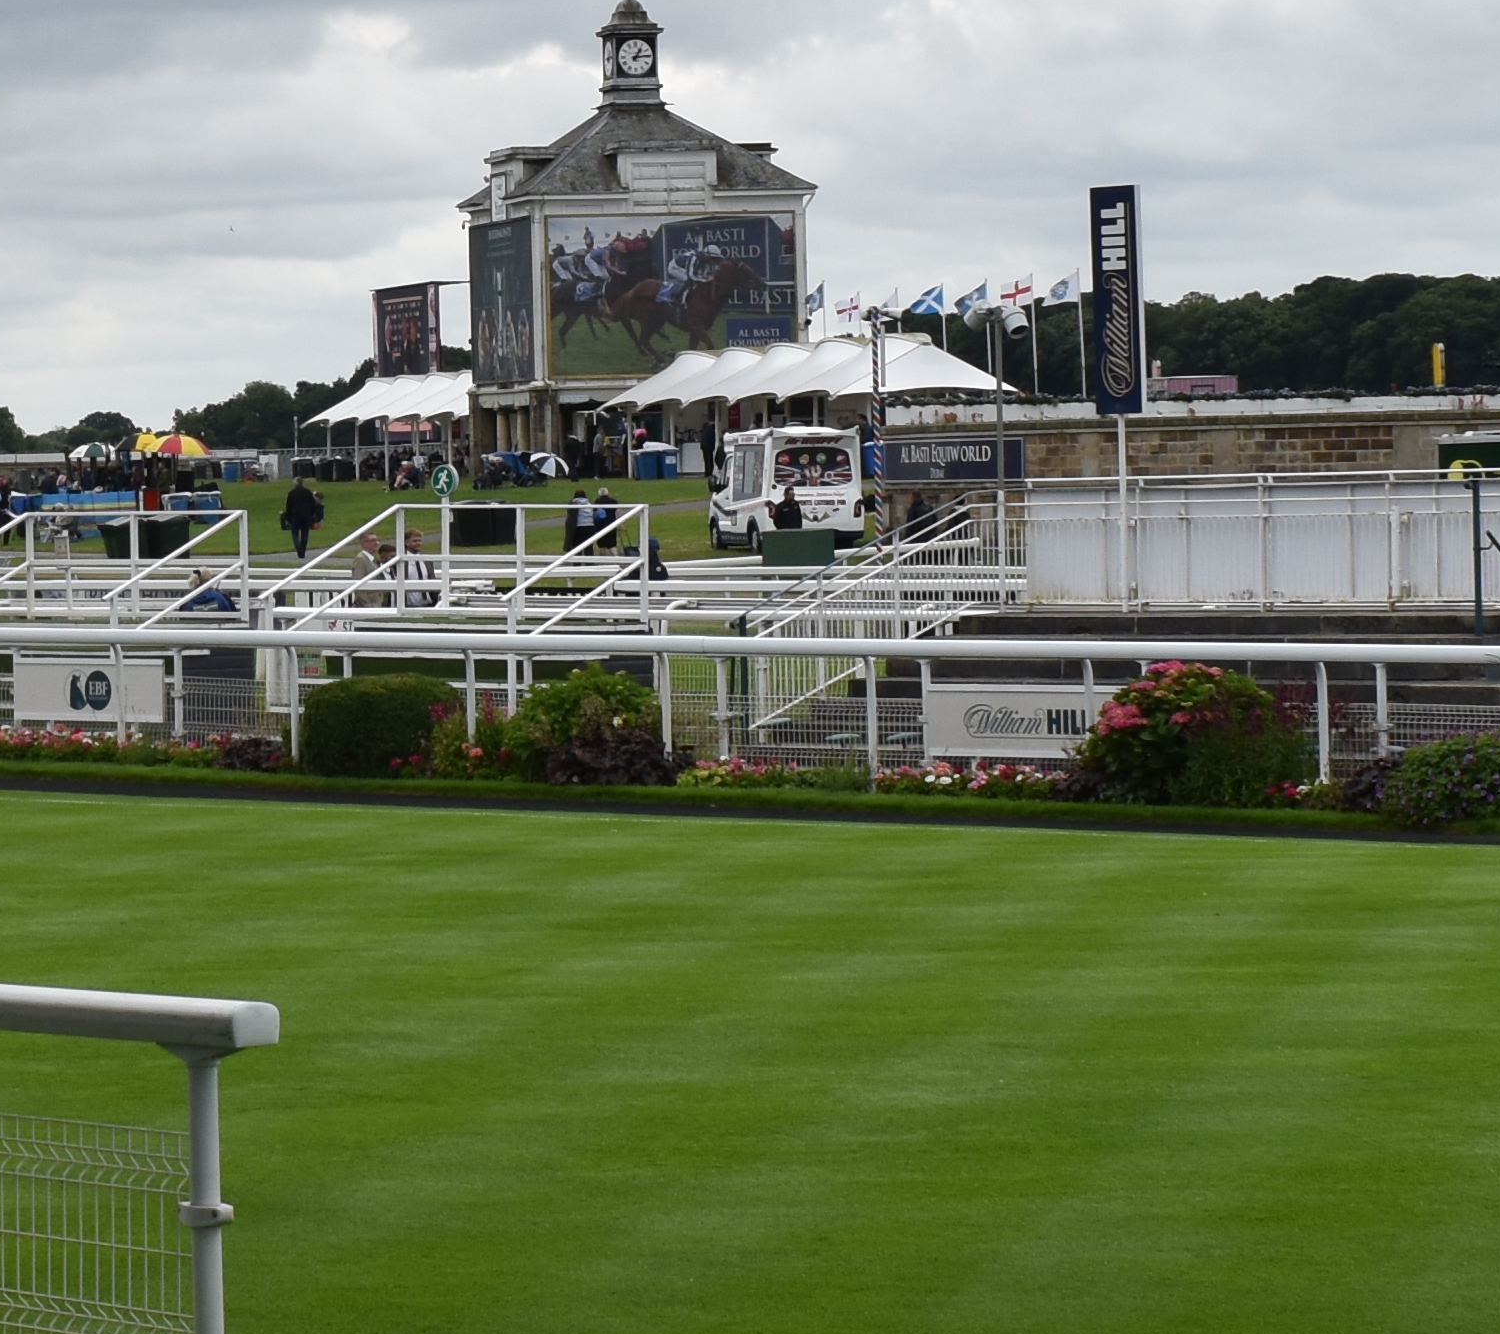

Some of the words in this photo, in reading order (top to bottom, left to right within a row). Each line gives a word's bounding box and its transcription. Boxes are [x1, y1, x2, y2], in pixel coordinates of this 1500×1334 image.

[706, 228, 746, 244] BASTI
[1100, 202, 1127, 270] HILL
[1102, 271, 1135, 397] William
[931, 444, 992, 467] EQUIWORLD
[88, 681, 109, 696] EBF
[963, 703, 1046, 736] William
